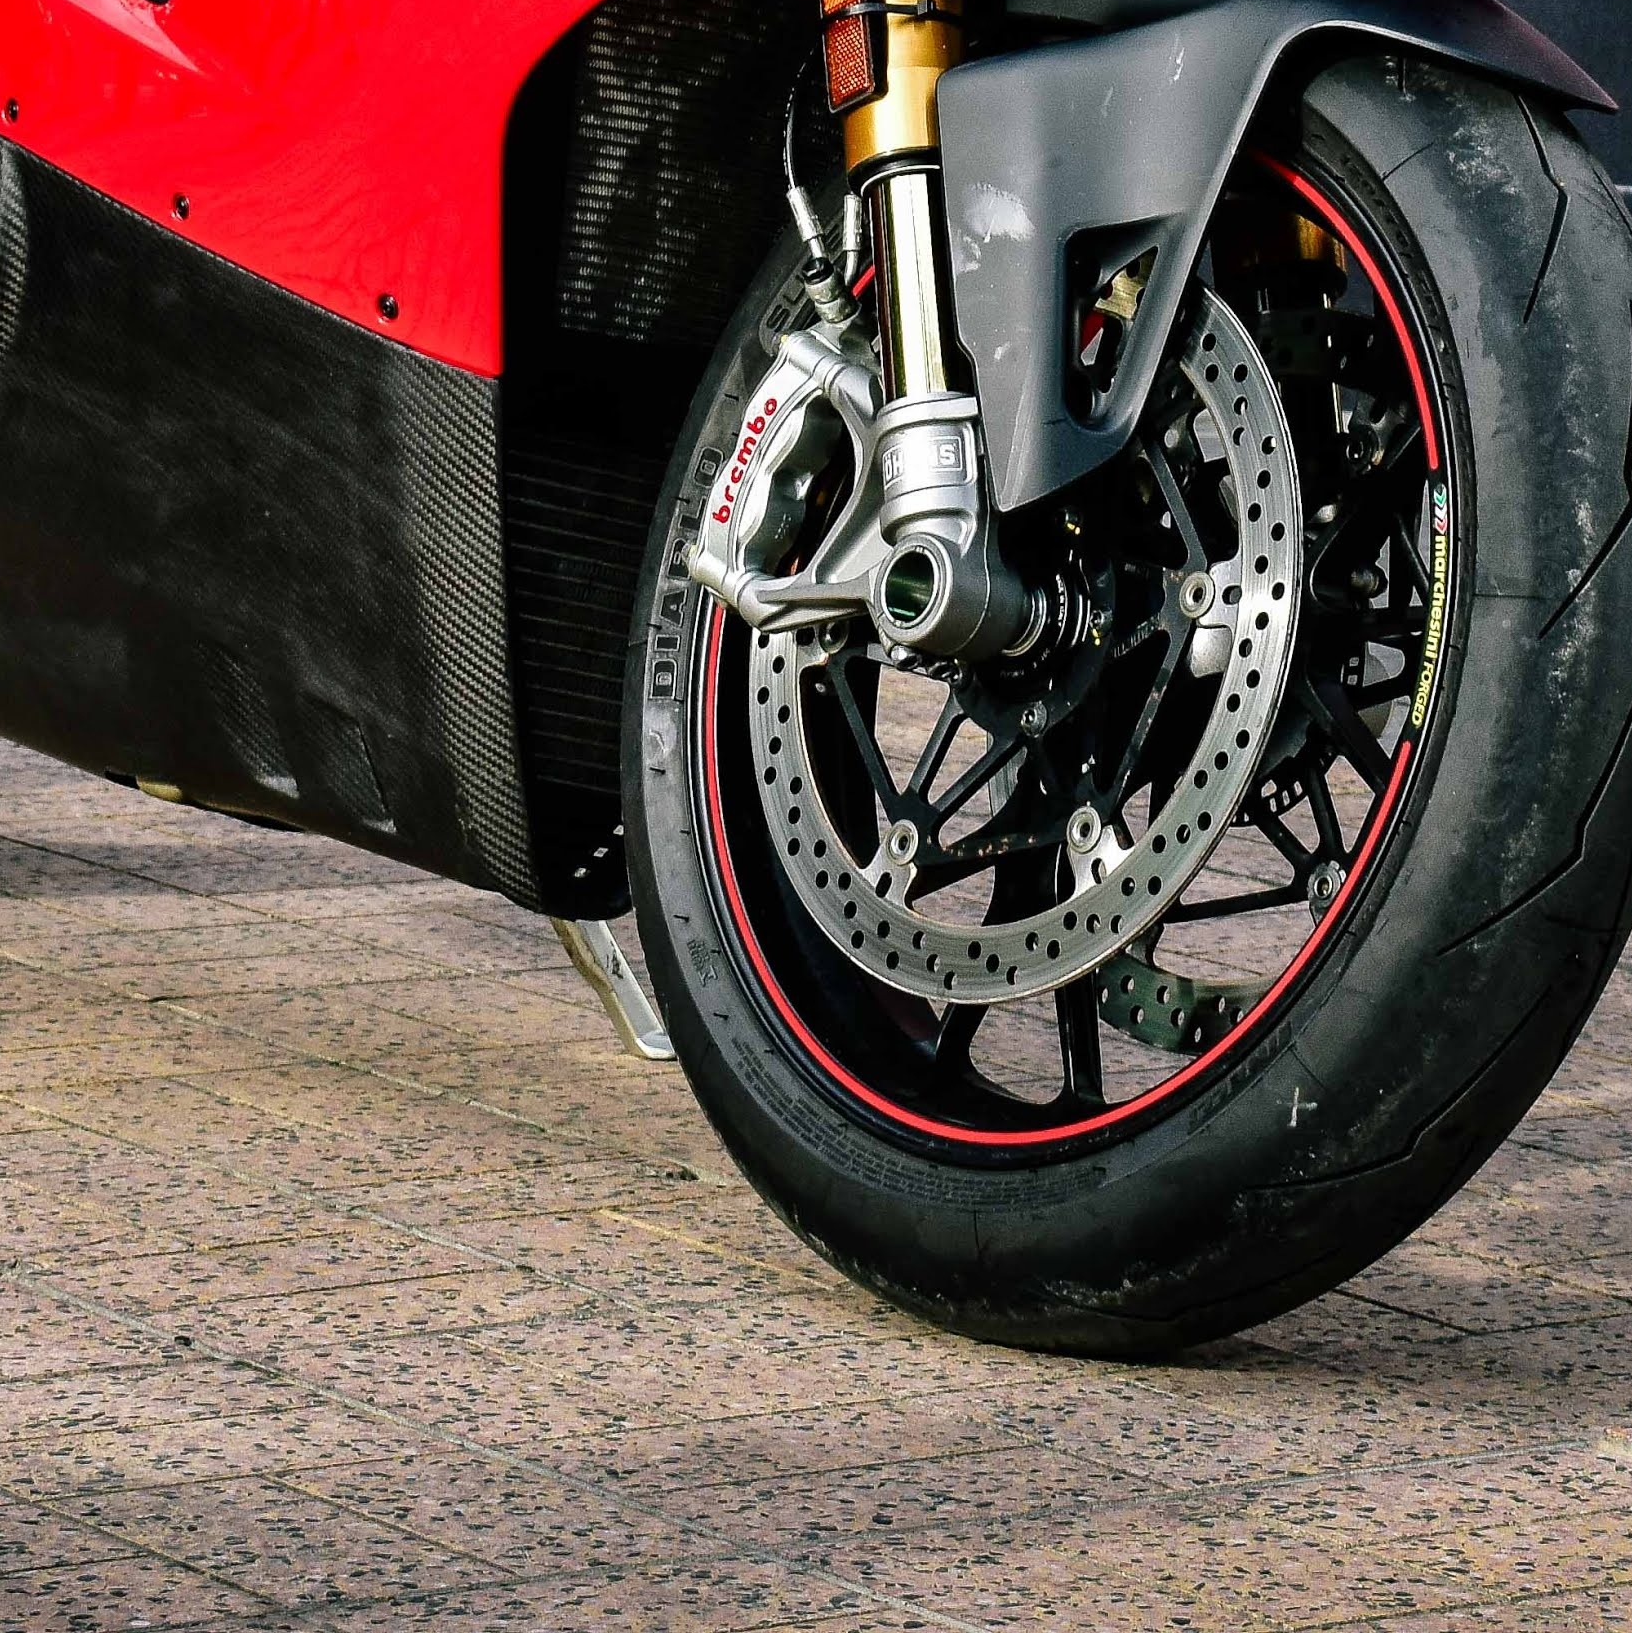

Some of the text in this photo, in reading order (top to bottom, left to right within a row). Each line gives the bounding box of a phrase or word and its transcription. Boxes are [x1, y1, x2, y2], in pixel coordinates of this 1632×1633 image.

[885, 441, 957, 484] ÖHS
[1411, 535, 1448, 729] marchesini FORGED
